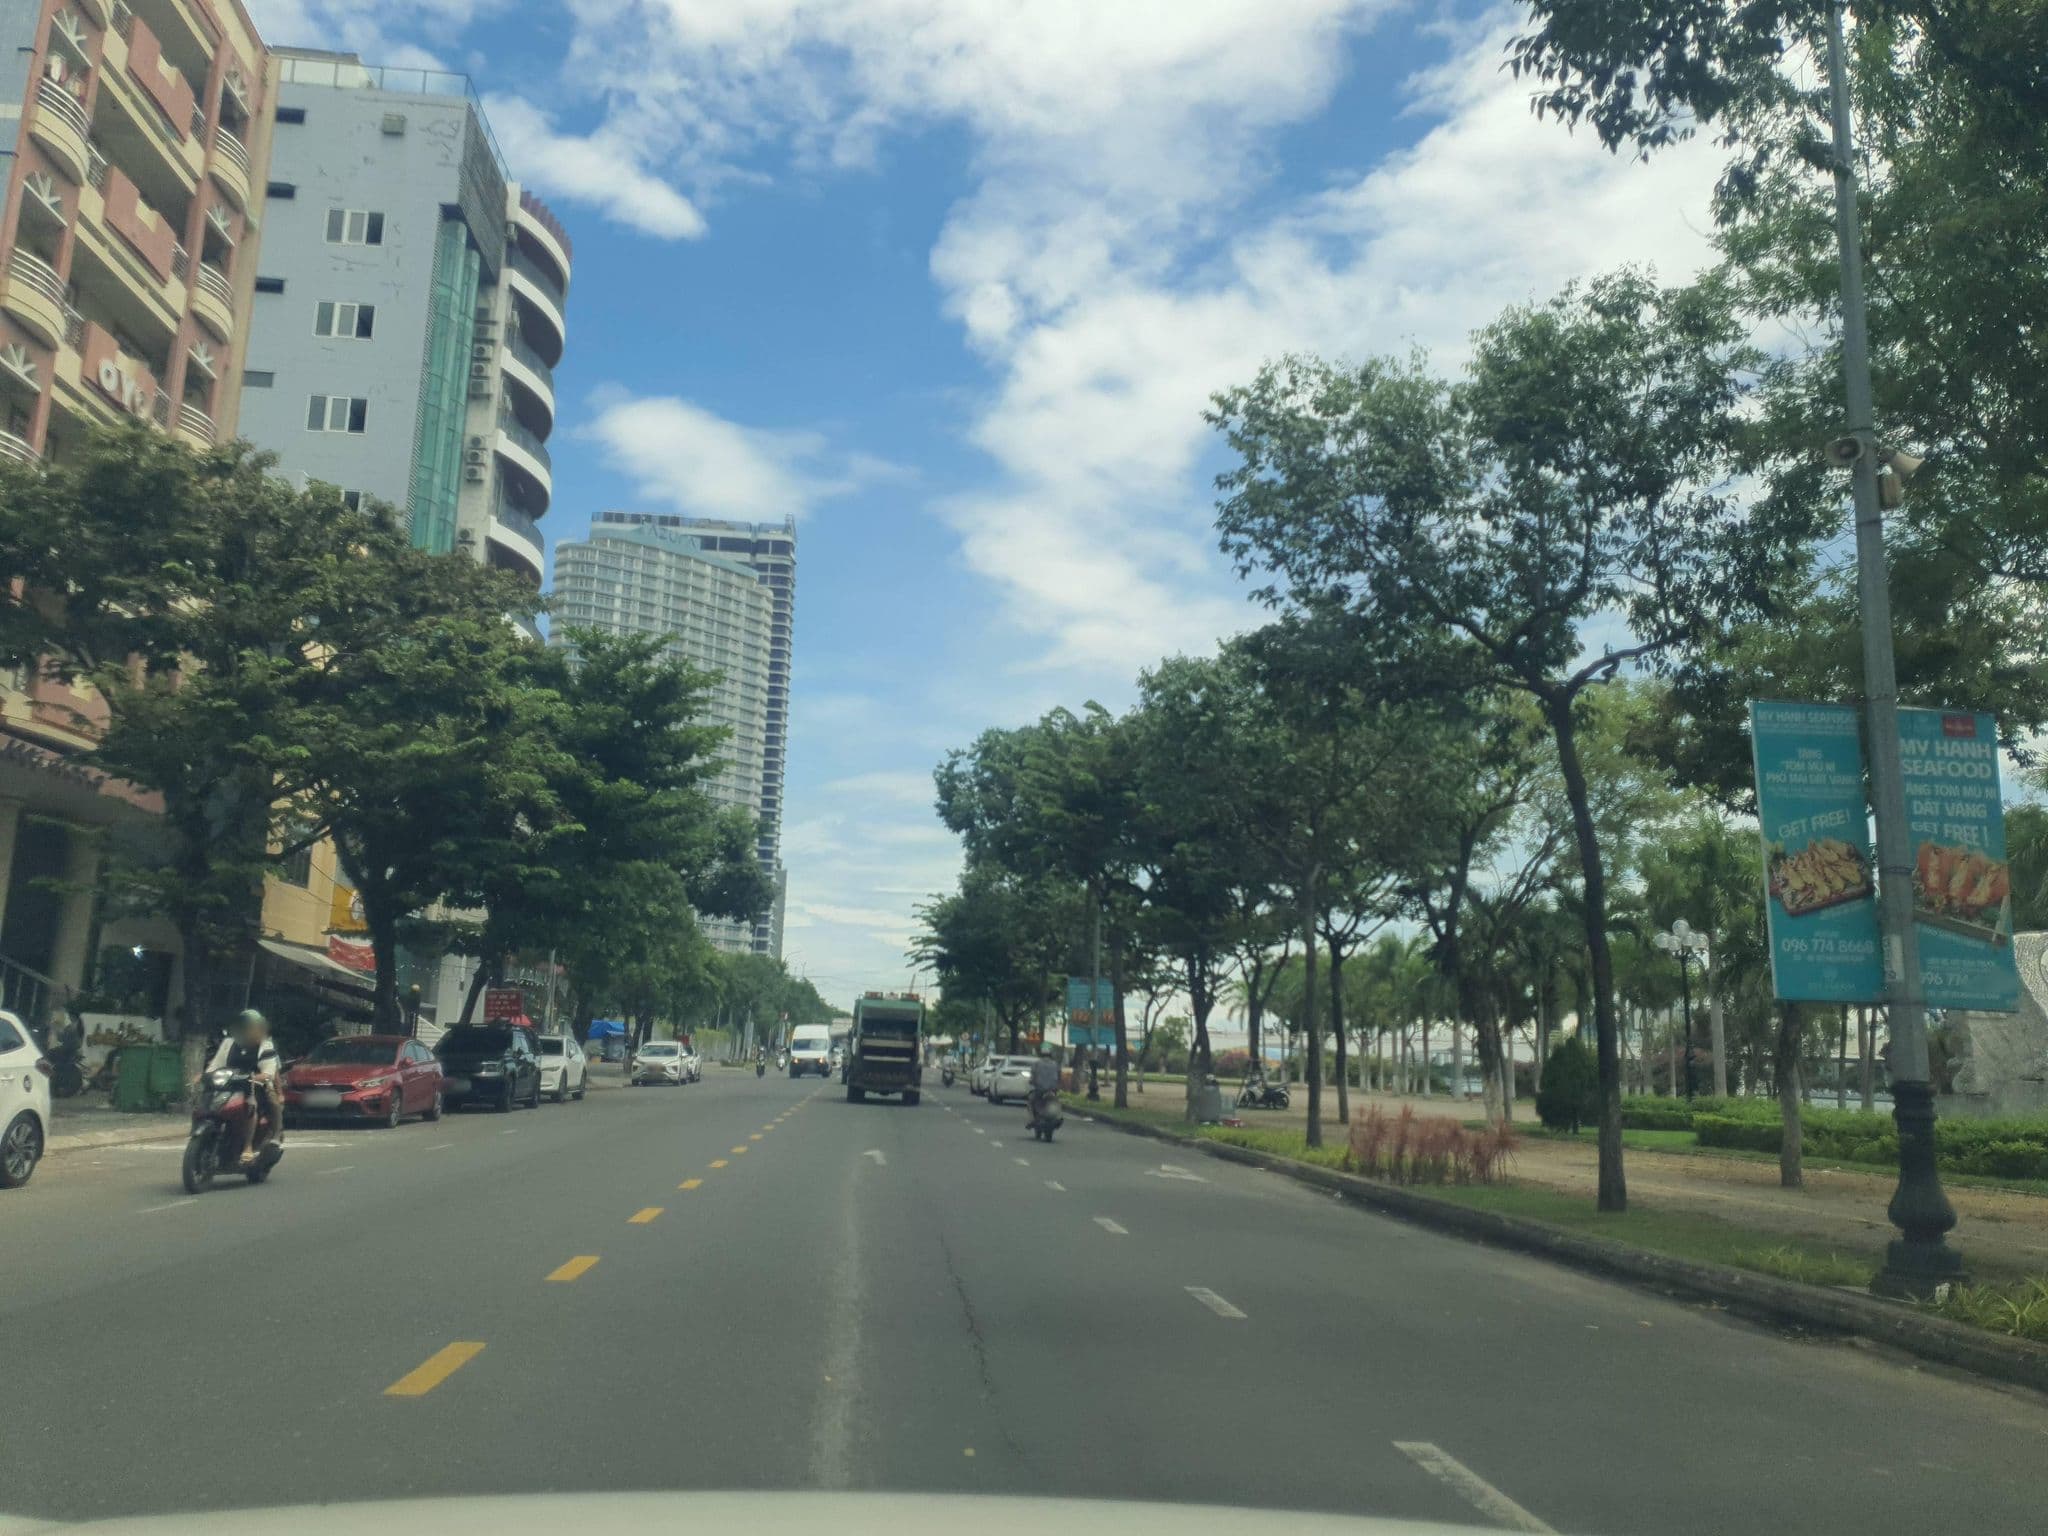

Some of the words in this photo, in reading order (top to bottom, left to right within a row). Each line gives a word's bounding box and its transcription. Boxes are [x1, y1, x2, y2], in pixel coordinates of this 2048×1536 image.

[1903, 759, 1991, 778] SEAFOOD
[1779, 818, 1807, 839] GET
[1912, 820, 1938, 835] GET
[1781, 938, 1809, 953] 096
